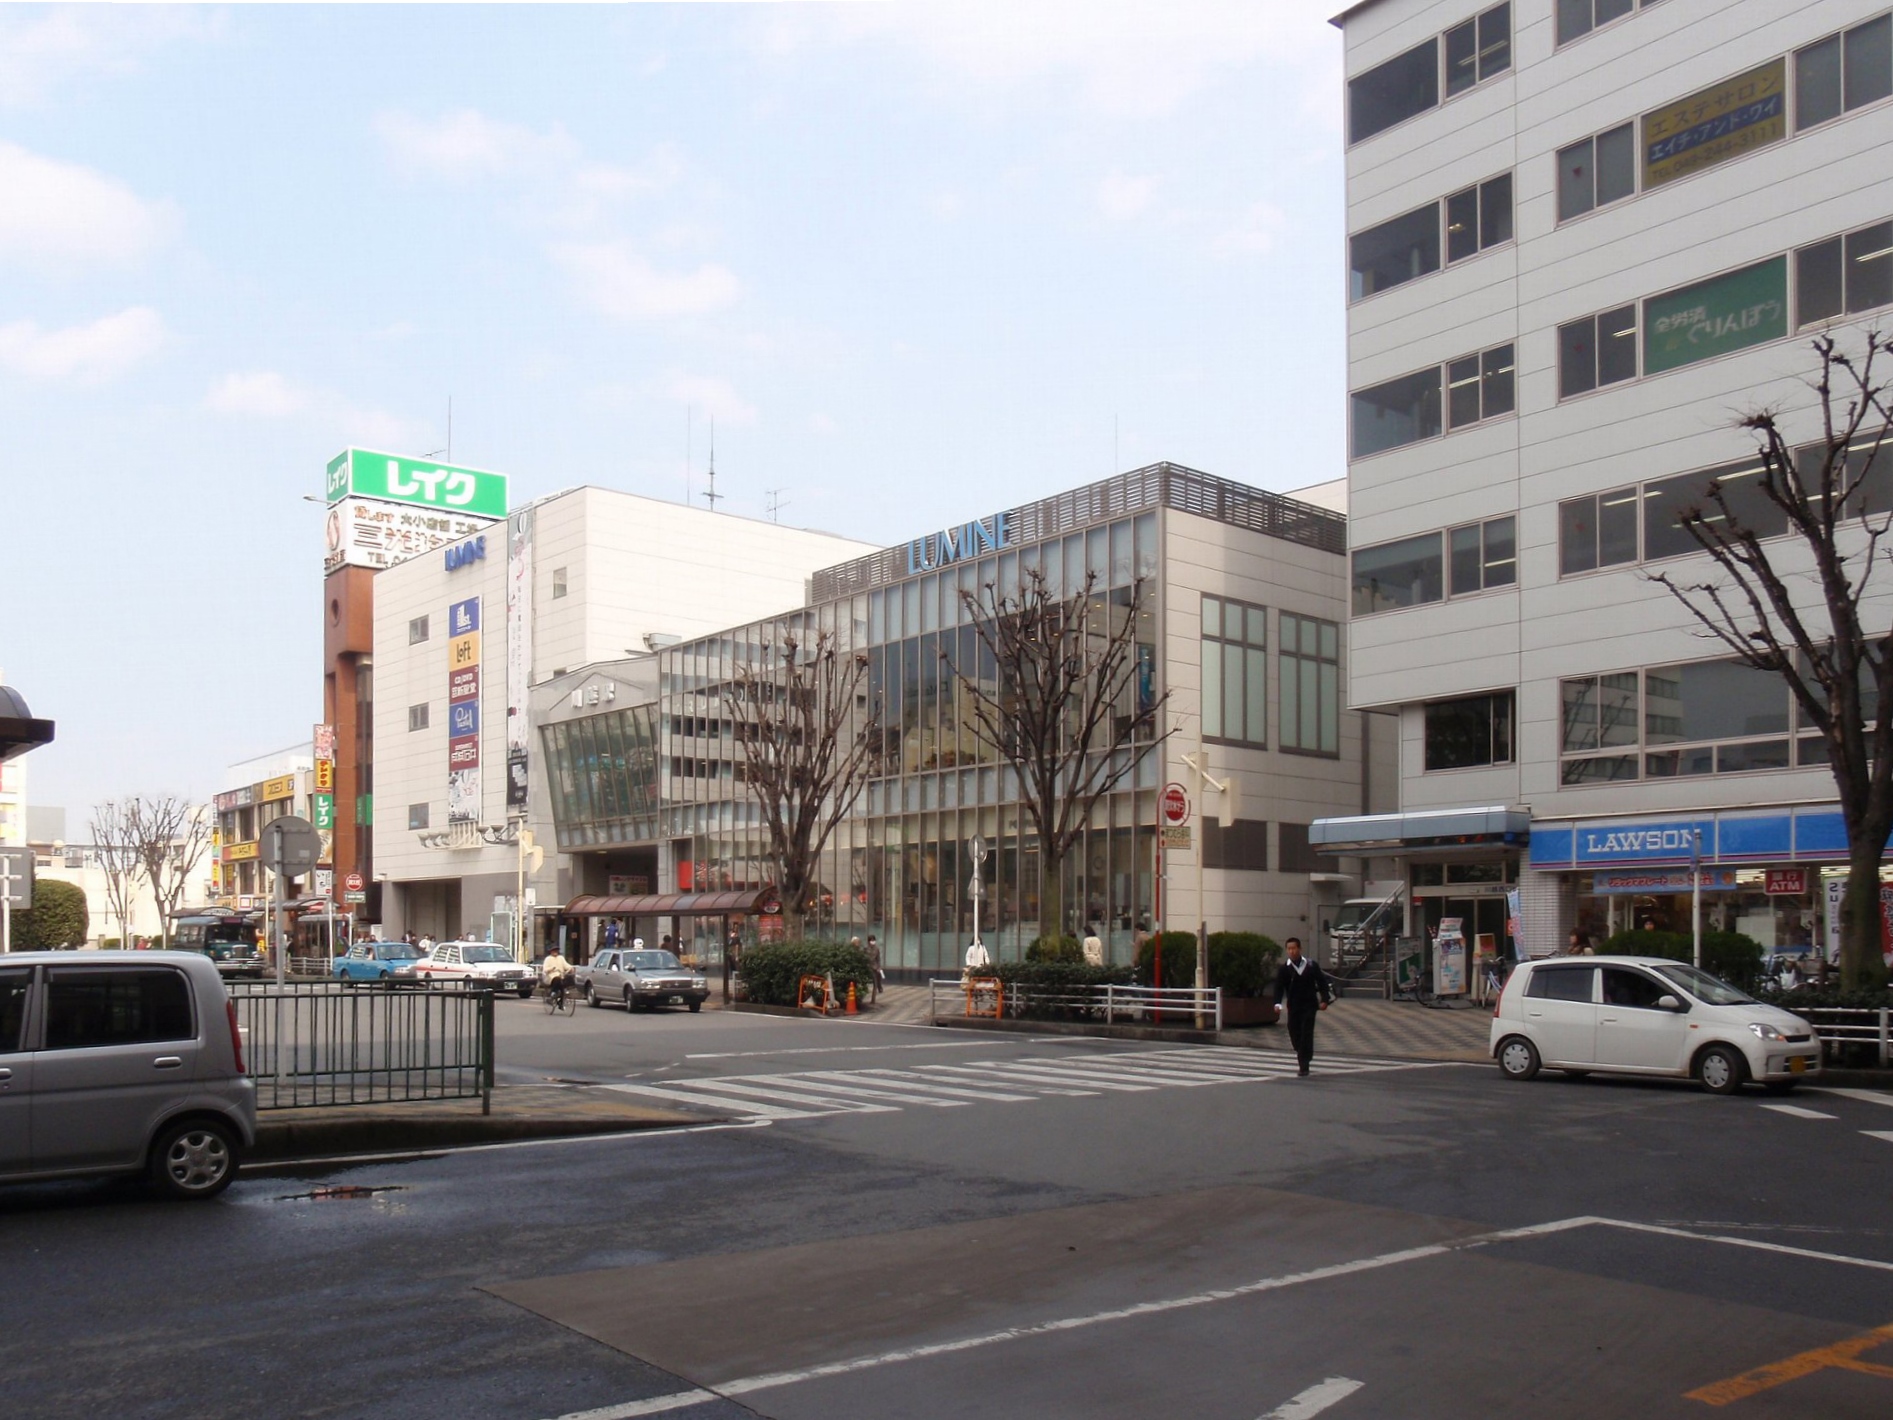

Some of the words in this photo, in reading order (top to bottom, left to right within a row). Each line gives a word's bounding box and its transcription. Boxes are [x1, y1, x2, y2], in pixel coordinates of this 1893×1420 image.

[1651, 75, 1778, 137] エステサロン
[327, 461, 348, 495] レイク
[387, 460, 476, 505] レイク
[908, 510, 1014, 575] LUMINE
[318, 796, 329, 826] レイク
[1587, 829, 1702, 853] LAWSON
[1769, 881, 1800, 891] ATM
